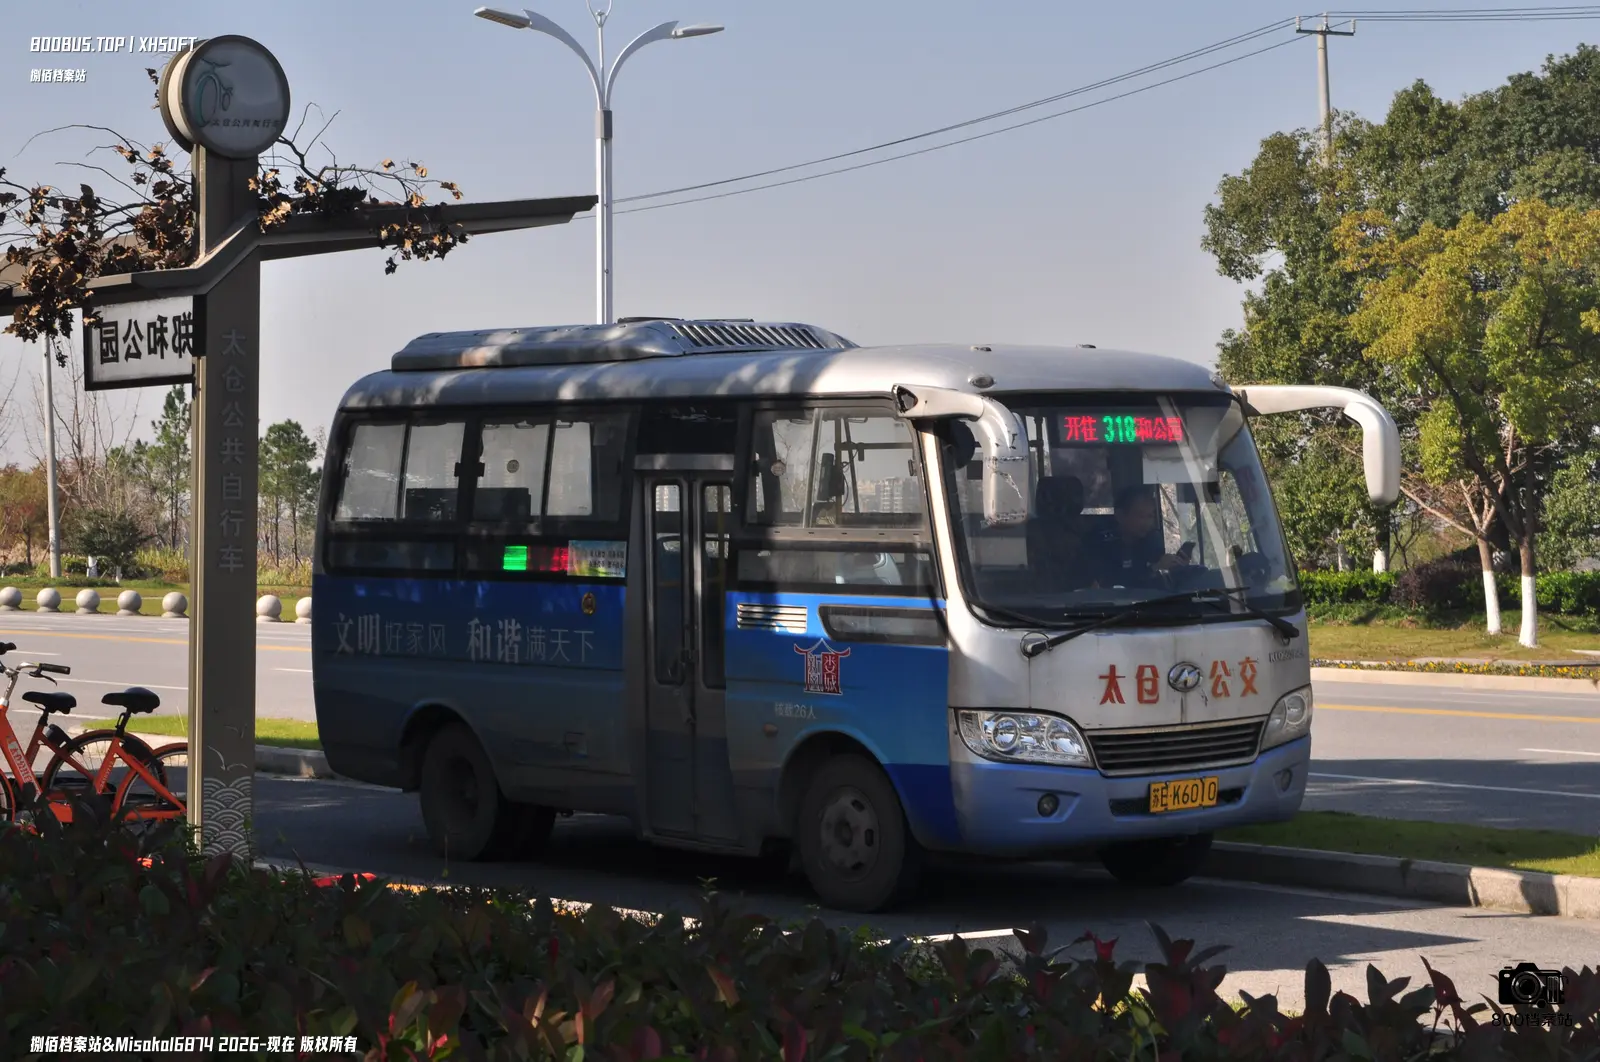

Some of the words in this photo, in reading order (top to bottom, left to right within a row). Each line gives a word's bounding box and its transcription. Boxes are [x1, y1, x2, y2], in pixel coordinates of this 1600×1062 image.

[219, 328, 246, 573] 太仓公共自行车
[333, 612, 446, 655] 文明好家风
[467, 618, 595, 664] 和谐满天下
[1098, 664, 1160, 705] 太仓
[1208, 656, 1259, 698] 公交
